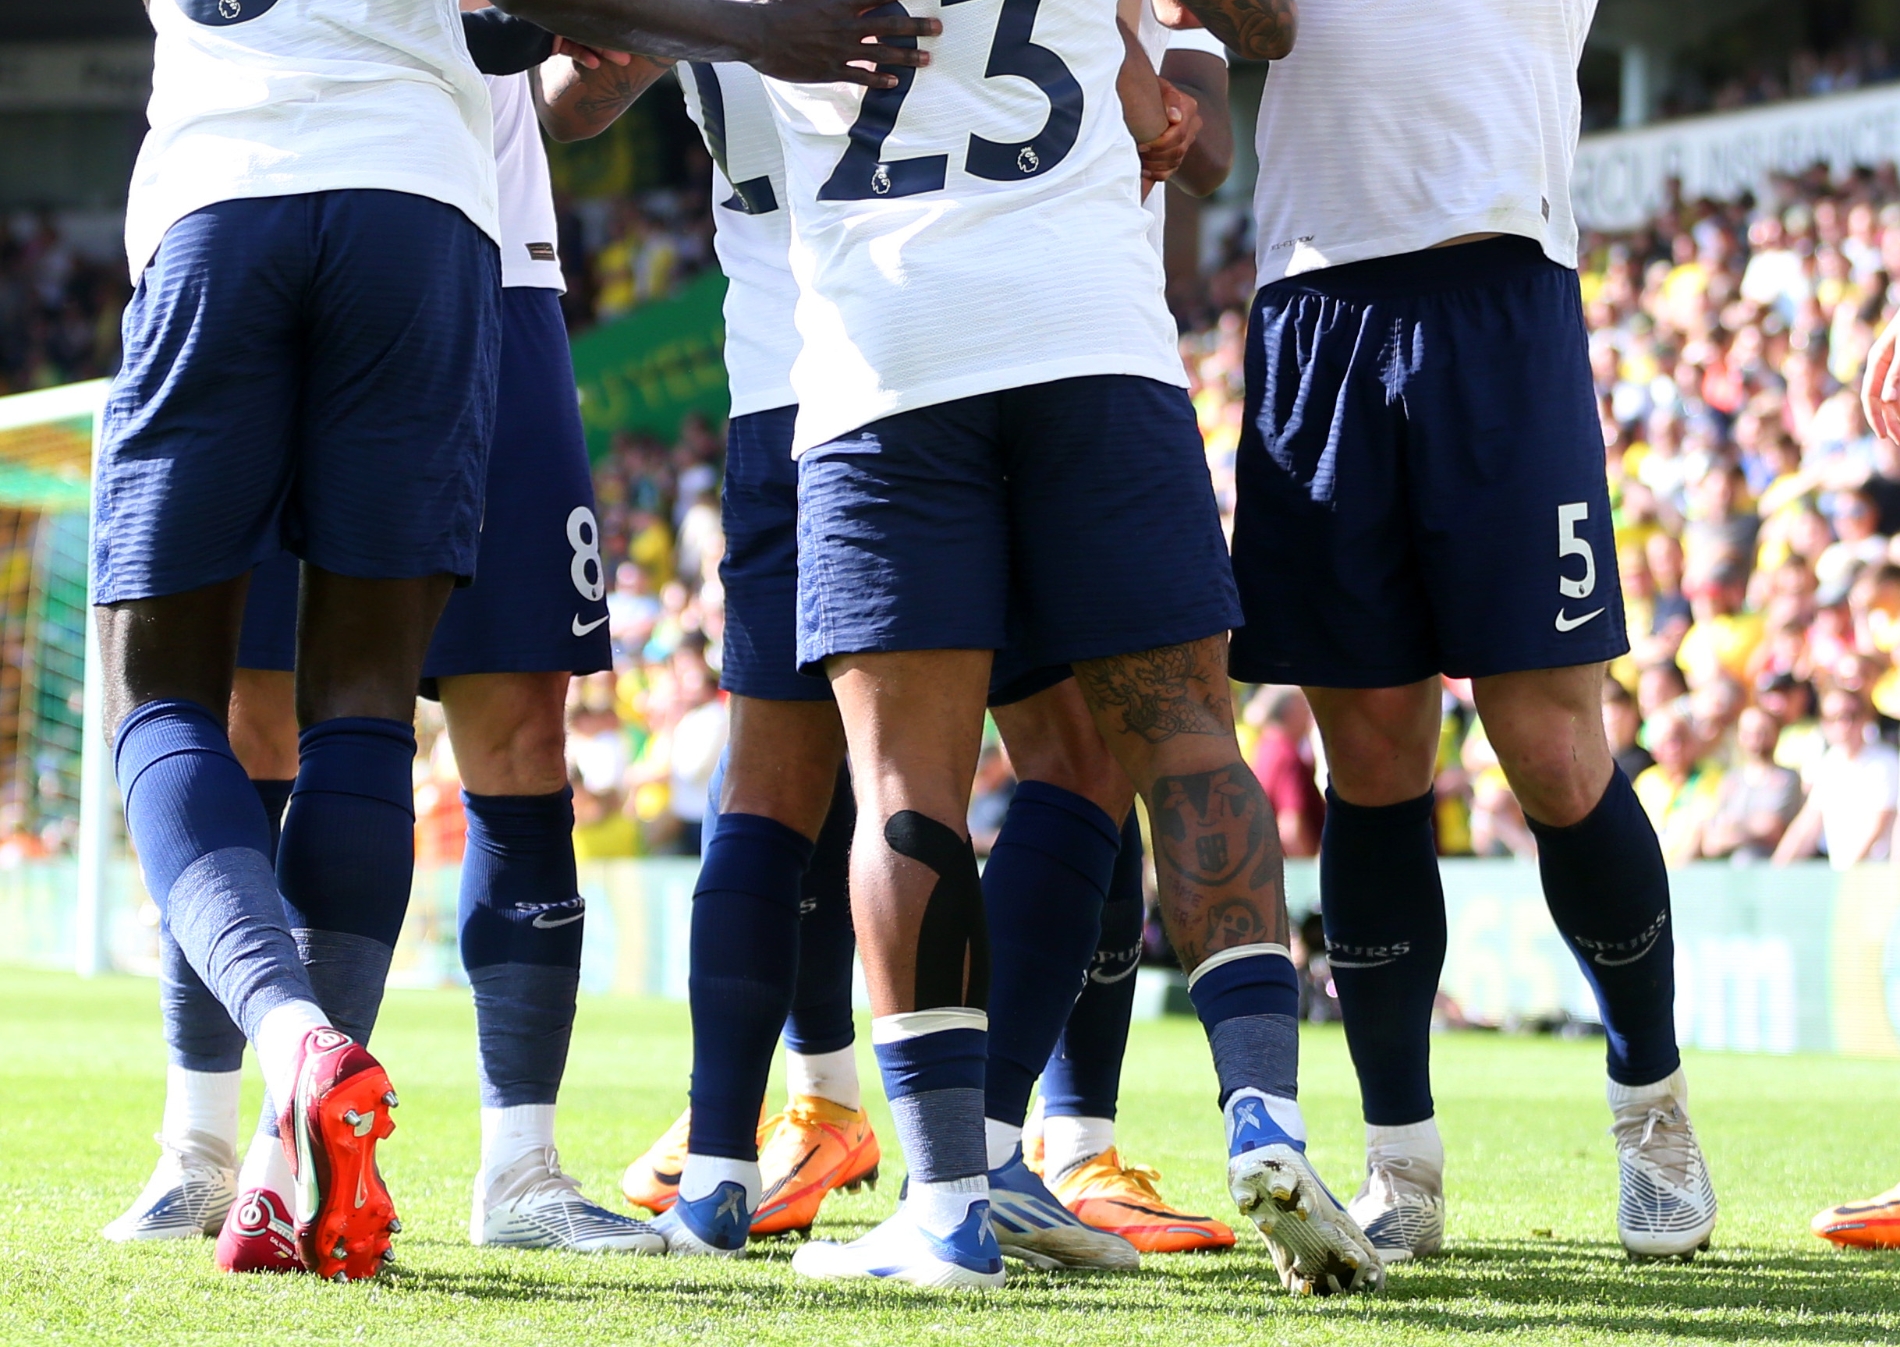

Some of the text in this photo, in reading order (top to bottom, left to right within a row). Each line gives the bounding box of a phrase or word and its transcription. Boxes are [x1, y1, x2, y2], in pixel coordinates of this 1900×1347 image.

[566, 505, 605, 602] 8
[1557, 501, 1596, 599] 5
[1324, 934, 1410, 958] PURS
[1574, 908, 1667, 951] SPURS
